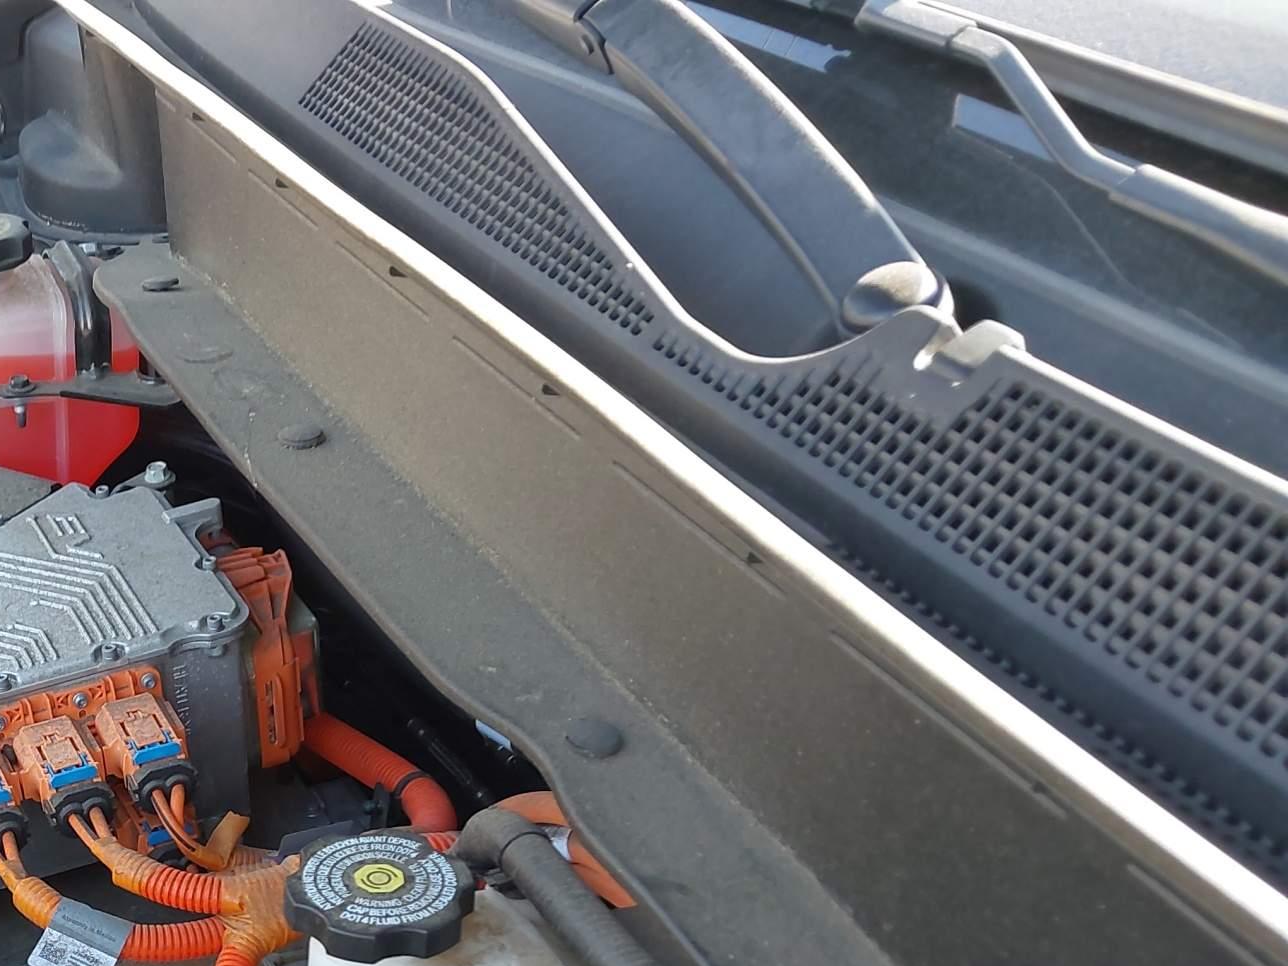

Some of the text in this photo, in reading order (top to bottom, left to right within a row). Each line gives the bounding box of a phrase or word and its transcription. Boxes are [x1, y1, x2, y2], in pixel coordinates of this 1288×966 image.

[357, 835, 387, 843] AVANT
[394, 845, 414, 855] DOT
[340, 910, 362, 923] DOT
[367, 916, 402, 925] FLUID
[400, 908, 433, 924] FROM
[429, 886, 458, 910] SEALED
[349, 904, 369, 915] CAP
